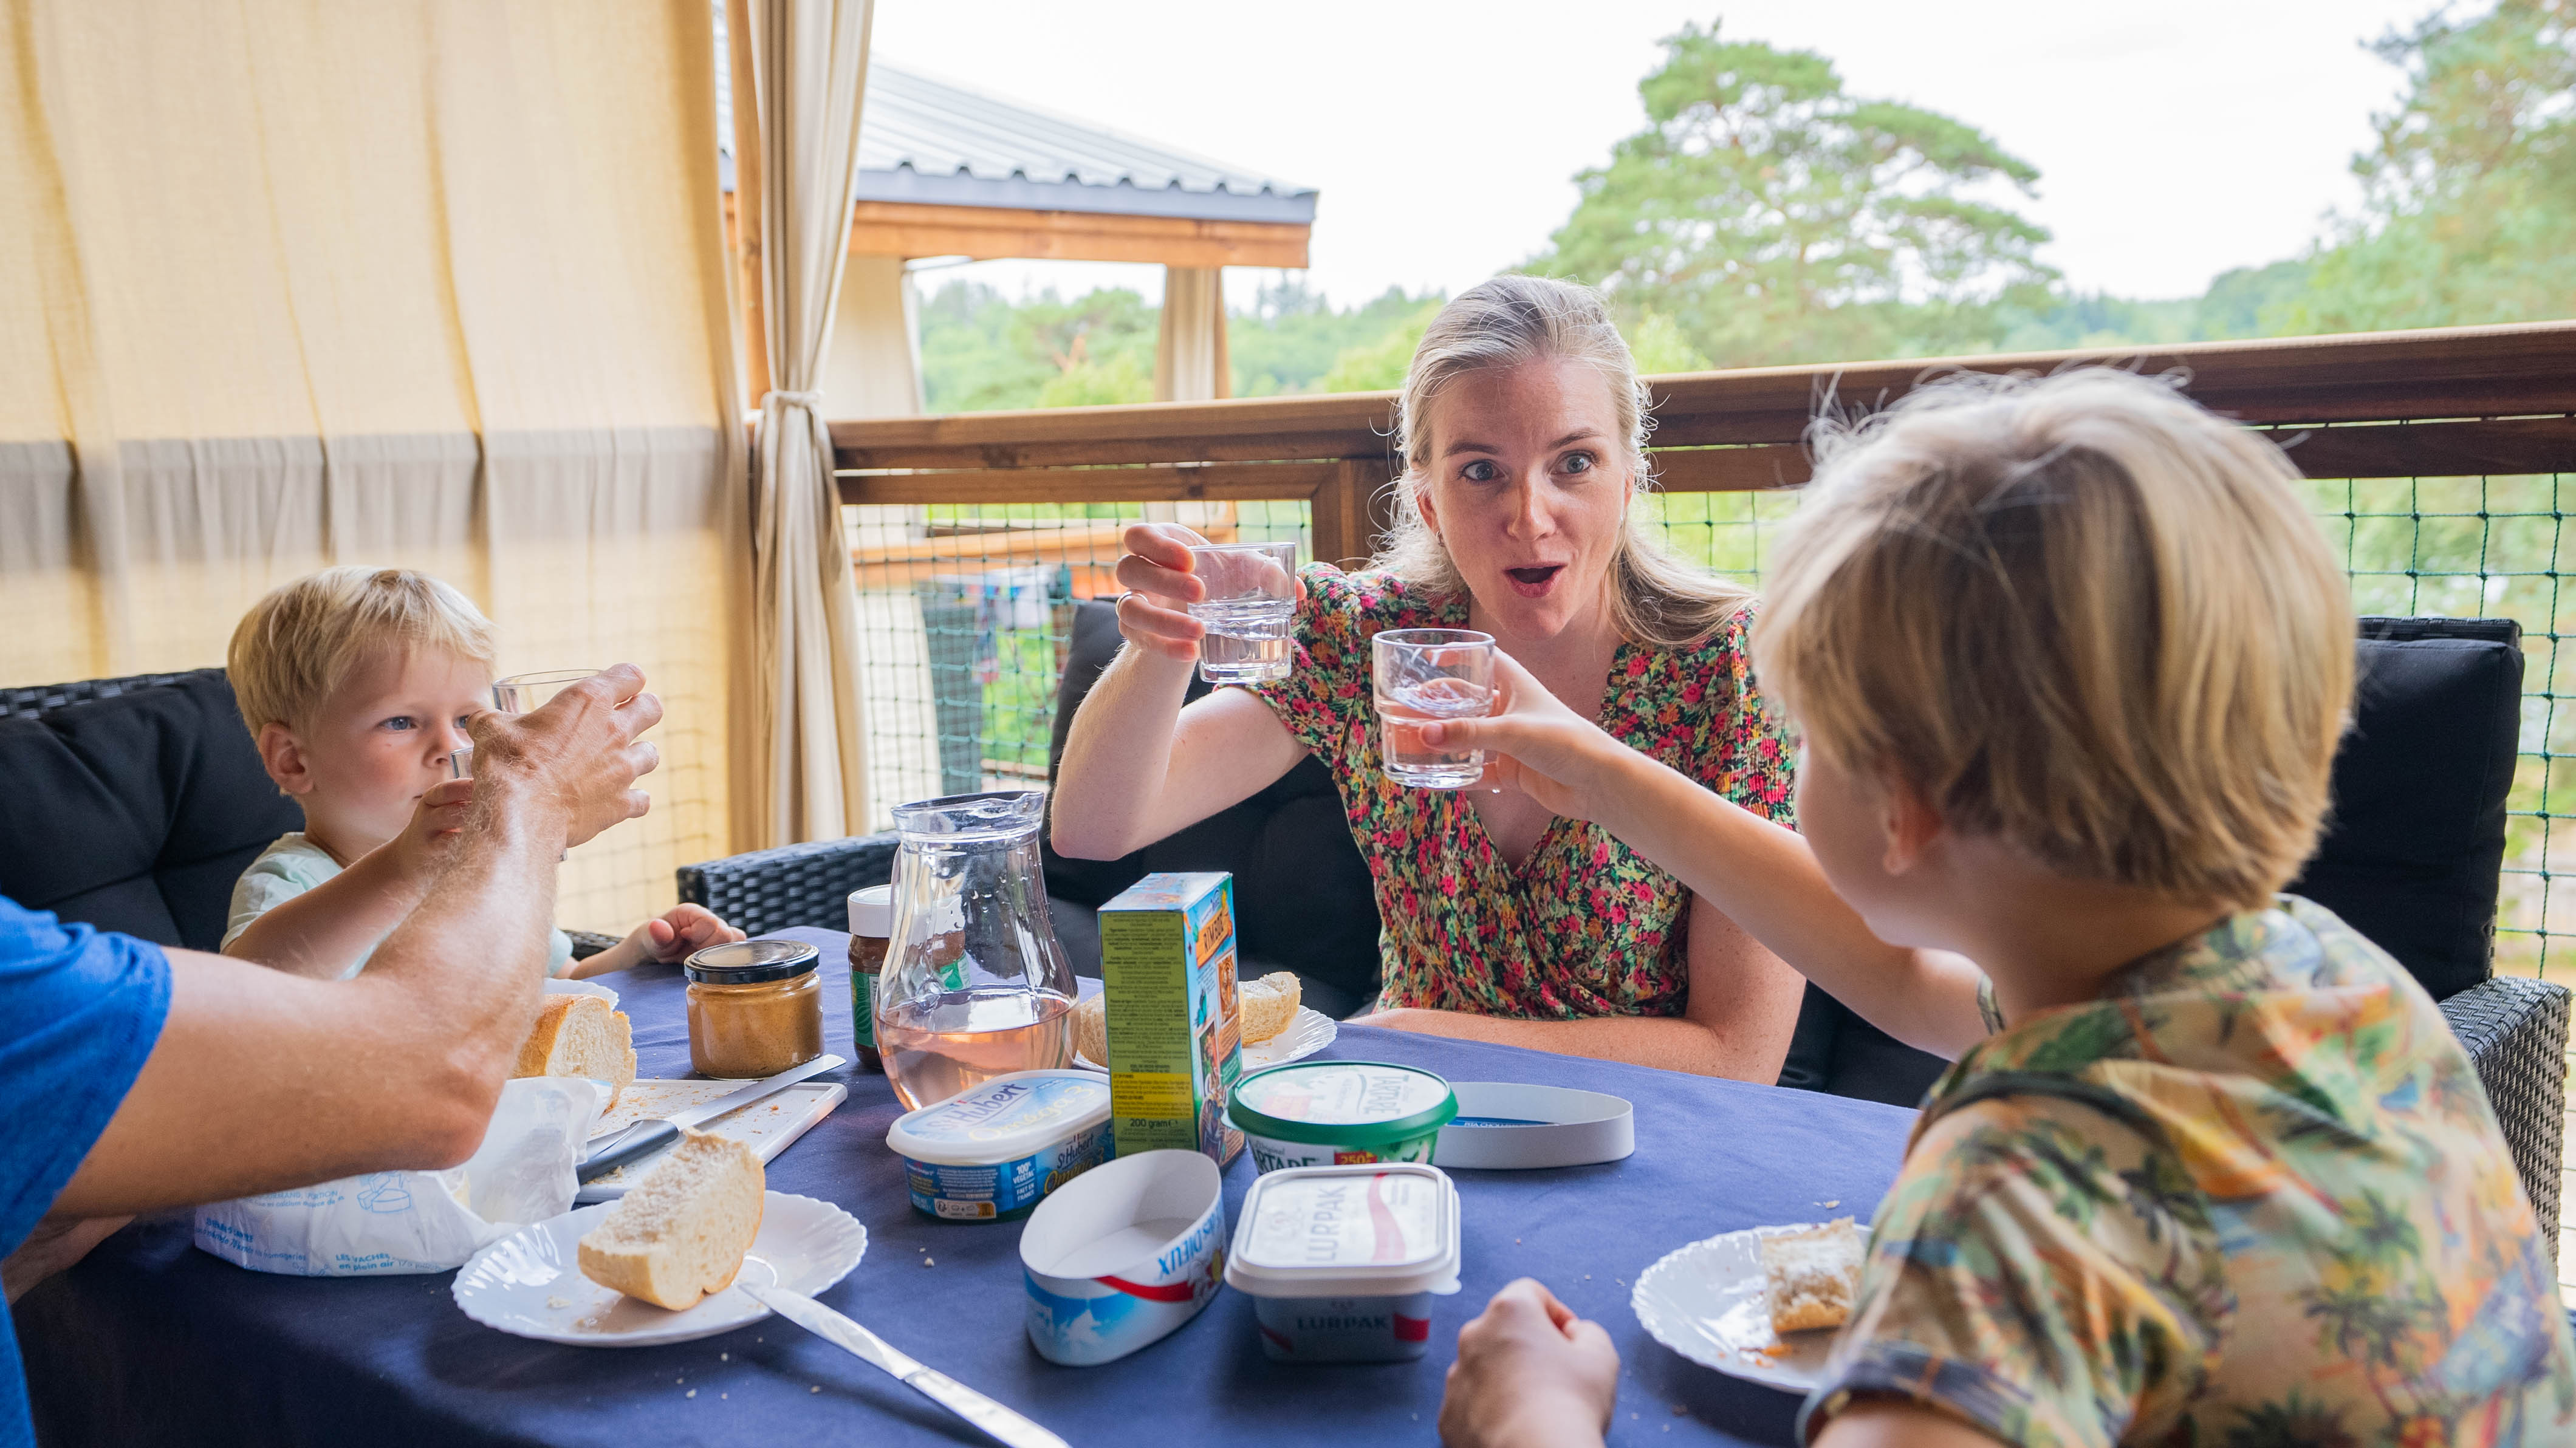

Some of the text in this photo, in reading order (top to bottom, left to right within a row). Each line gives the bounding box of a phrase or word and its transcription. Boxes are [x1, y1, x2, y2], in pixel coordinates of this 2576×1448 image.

[1204, 913, 1224, 954] RIMBOE
[942, 1083, 1028, 1122] Hubert
[1064, 1085, 1095, 1098] 3
[1364, 1074, 1410, 1115] TARTARE
[1130, 1118, 1167, 1129] 200 gram
[1066, 1133, 1094, 1164] Hubert
[1018, 1189, 1035, 1202] FRANCE
[1306, 1186, 1347, 1262] LURPAK
[1156, 1229, 1203, 1280] DIEUX
[1297, 1316, 1388, 1329] LURPAK
